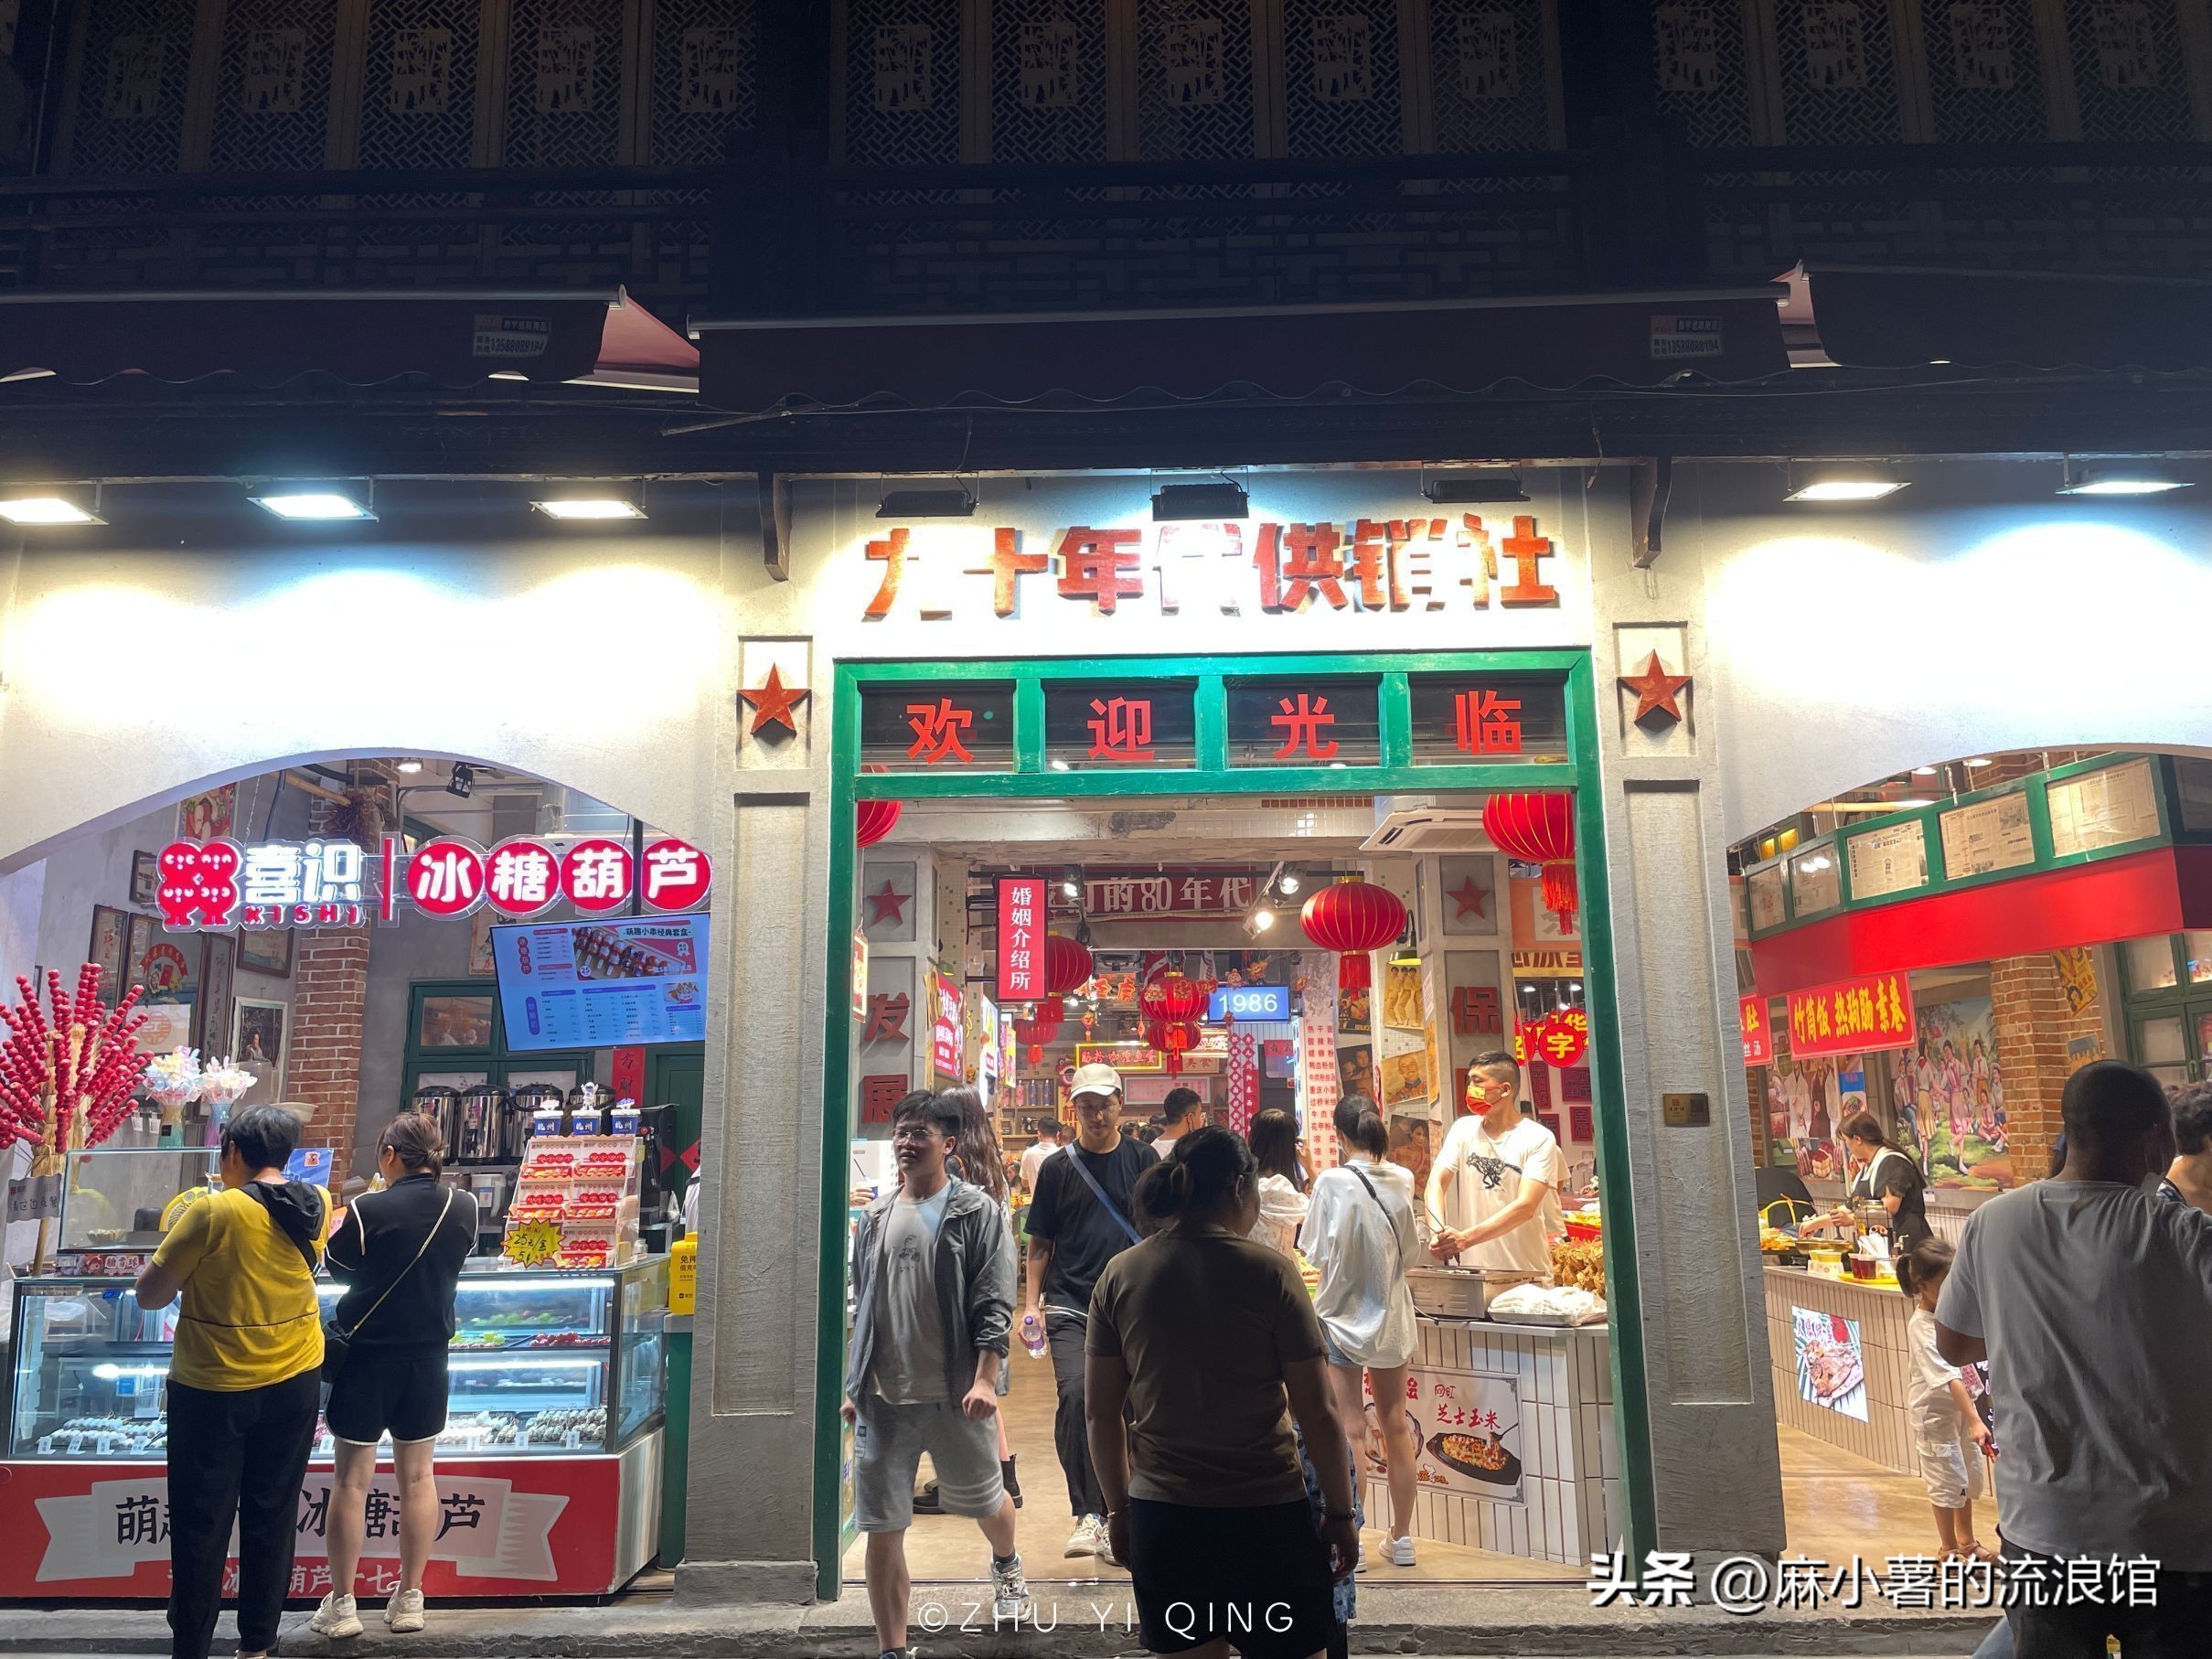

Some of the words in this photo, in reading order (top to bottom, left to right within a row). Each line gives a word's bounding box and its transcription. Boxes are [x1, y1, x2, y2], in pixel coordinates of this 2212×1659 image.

[245, 842, 361, 904] 喜识
[417, 847, 700, 904] 冰糖葫芦
[244, 904, 361, 925] XISHI
[1010, 885, 1032, 991] 婚姻介绍所
[1218, 993, 1278, 1012] 1986
[1450, 986, 1501, 1036] 保
[1794, 995, 1832, 1045] 竹筒饭
[1833, 986, 1875, 1039] 热狗肠
[1875, 975, 1907, 1034] 素卷
[1740, 1002, 1760, 1033] 肚
[1546, 1032, 1576, 1059] 字
[1309, 1086, 1336, 1094] 重庆小面
[1311, 1122, 1335, 1130] 花甲粉
[1437, 1403, 1501, 1430] 芝士玉米
